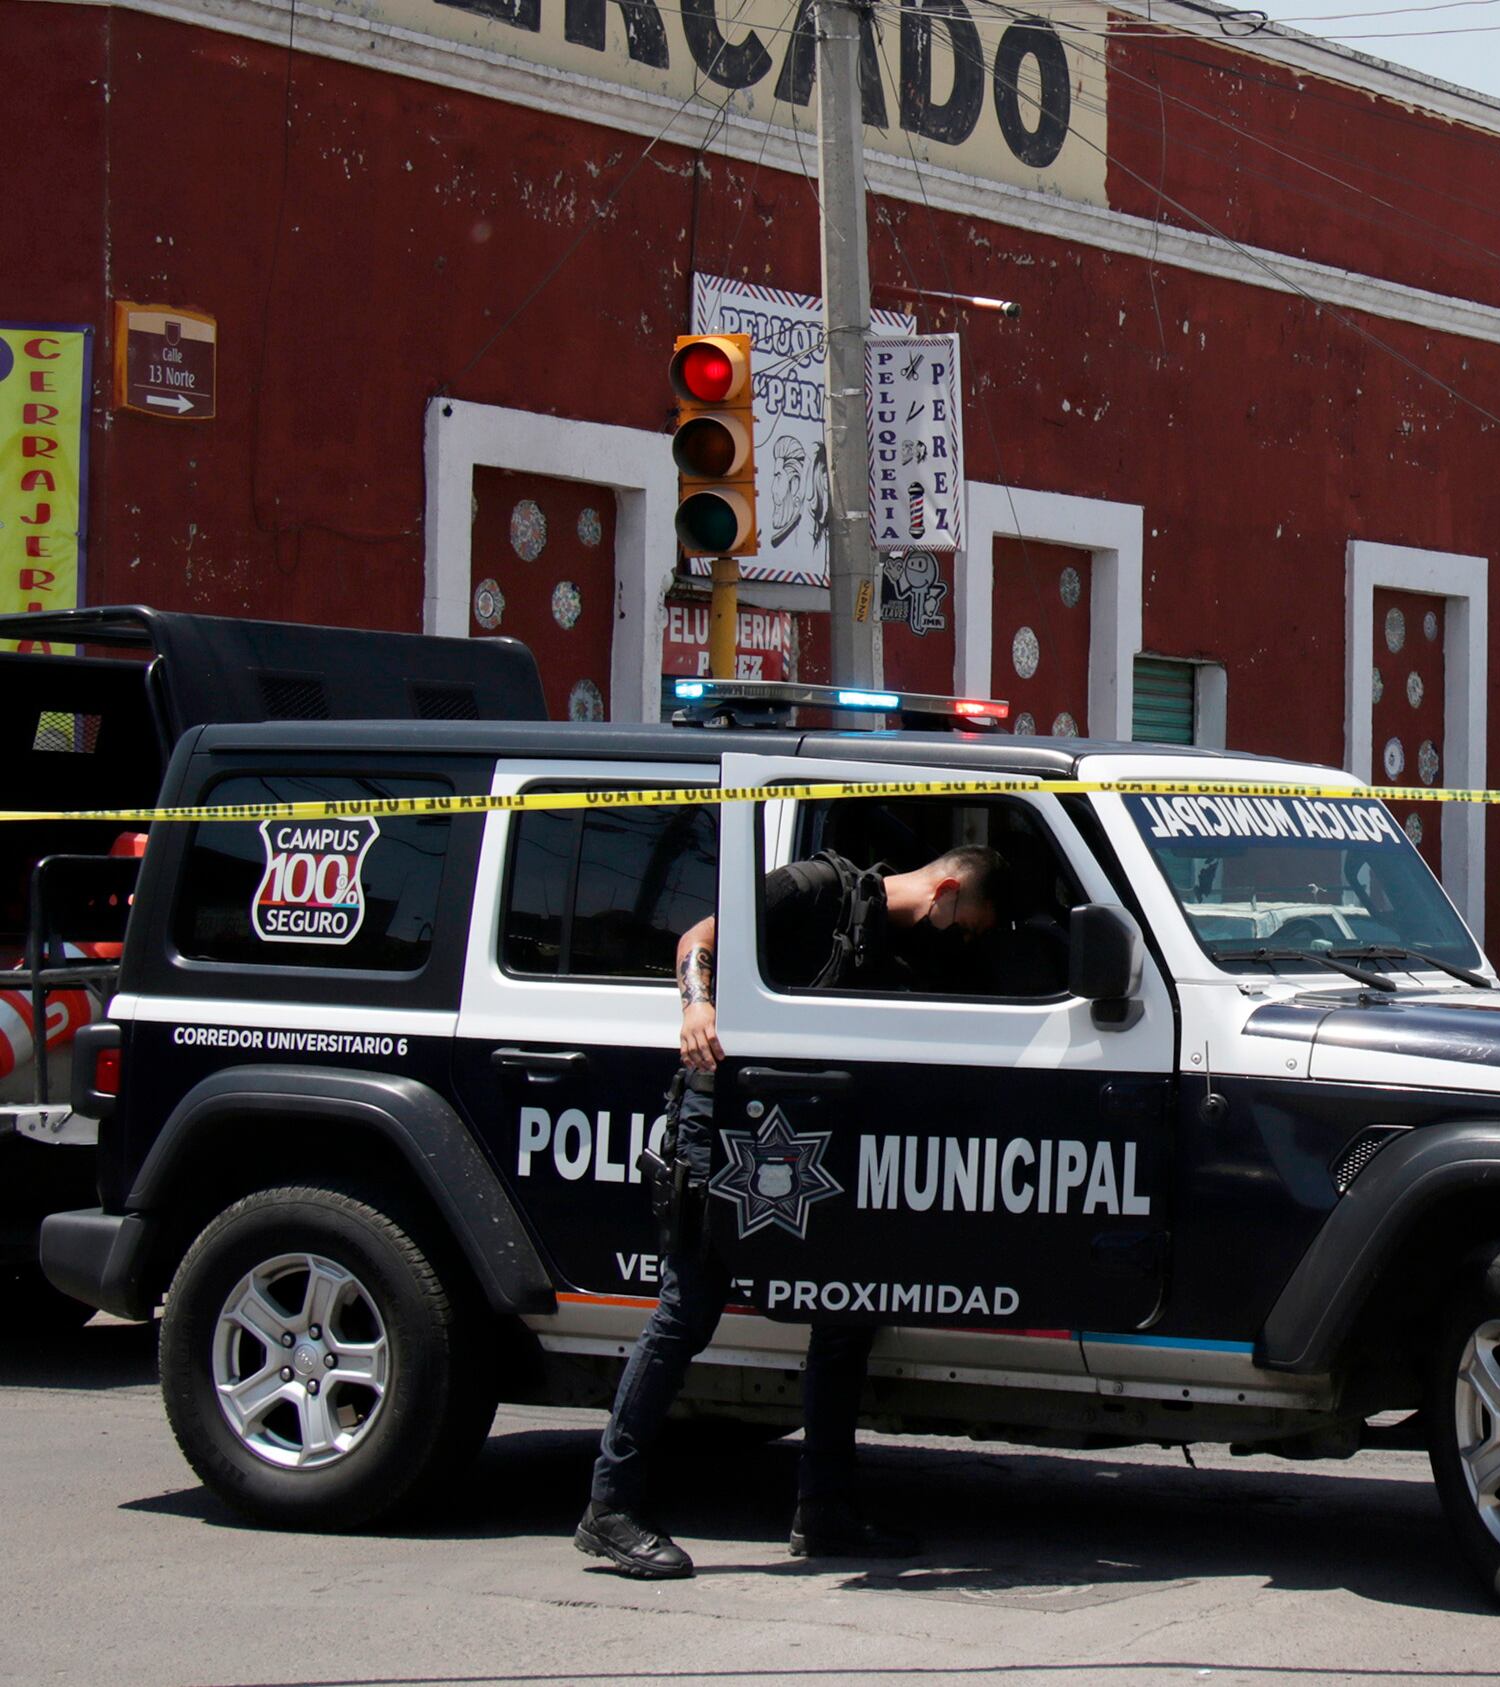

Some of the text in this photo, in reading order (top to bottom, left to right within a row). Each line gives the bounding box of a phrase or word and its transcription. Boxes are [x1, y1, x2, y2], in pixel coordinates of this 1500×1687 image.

[435, 0, 1071, 168] CADO
[162, 348, 183, 363] Calle
[149, 364, 195, 389] 13 Norte
[878, 353, 899, 539] PELUQUERIA
[931, 362, 949, 530] PEREZ
[661, 606, 781, 652] ELUERIA
[697, 651, 763, 680] PEZ
[277, 827, 360, 852] CAMPUS
[268, 853, 358, 905] 100%
[265, 909, 348, 934] SEGURO
[173, 1027, 408, 1055] CORREDOR UNIVERSITARIO 6
[517, 1107, 1151, 1216] POLI MUNICIPAL
[767, 1281, 1020, 1316] PROXIMIDAD
